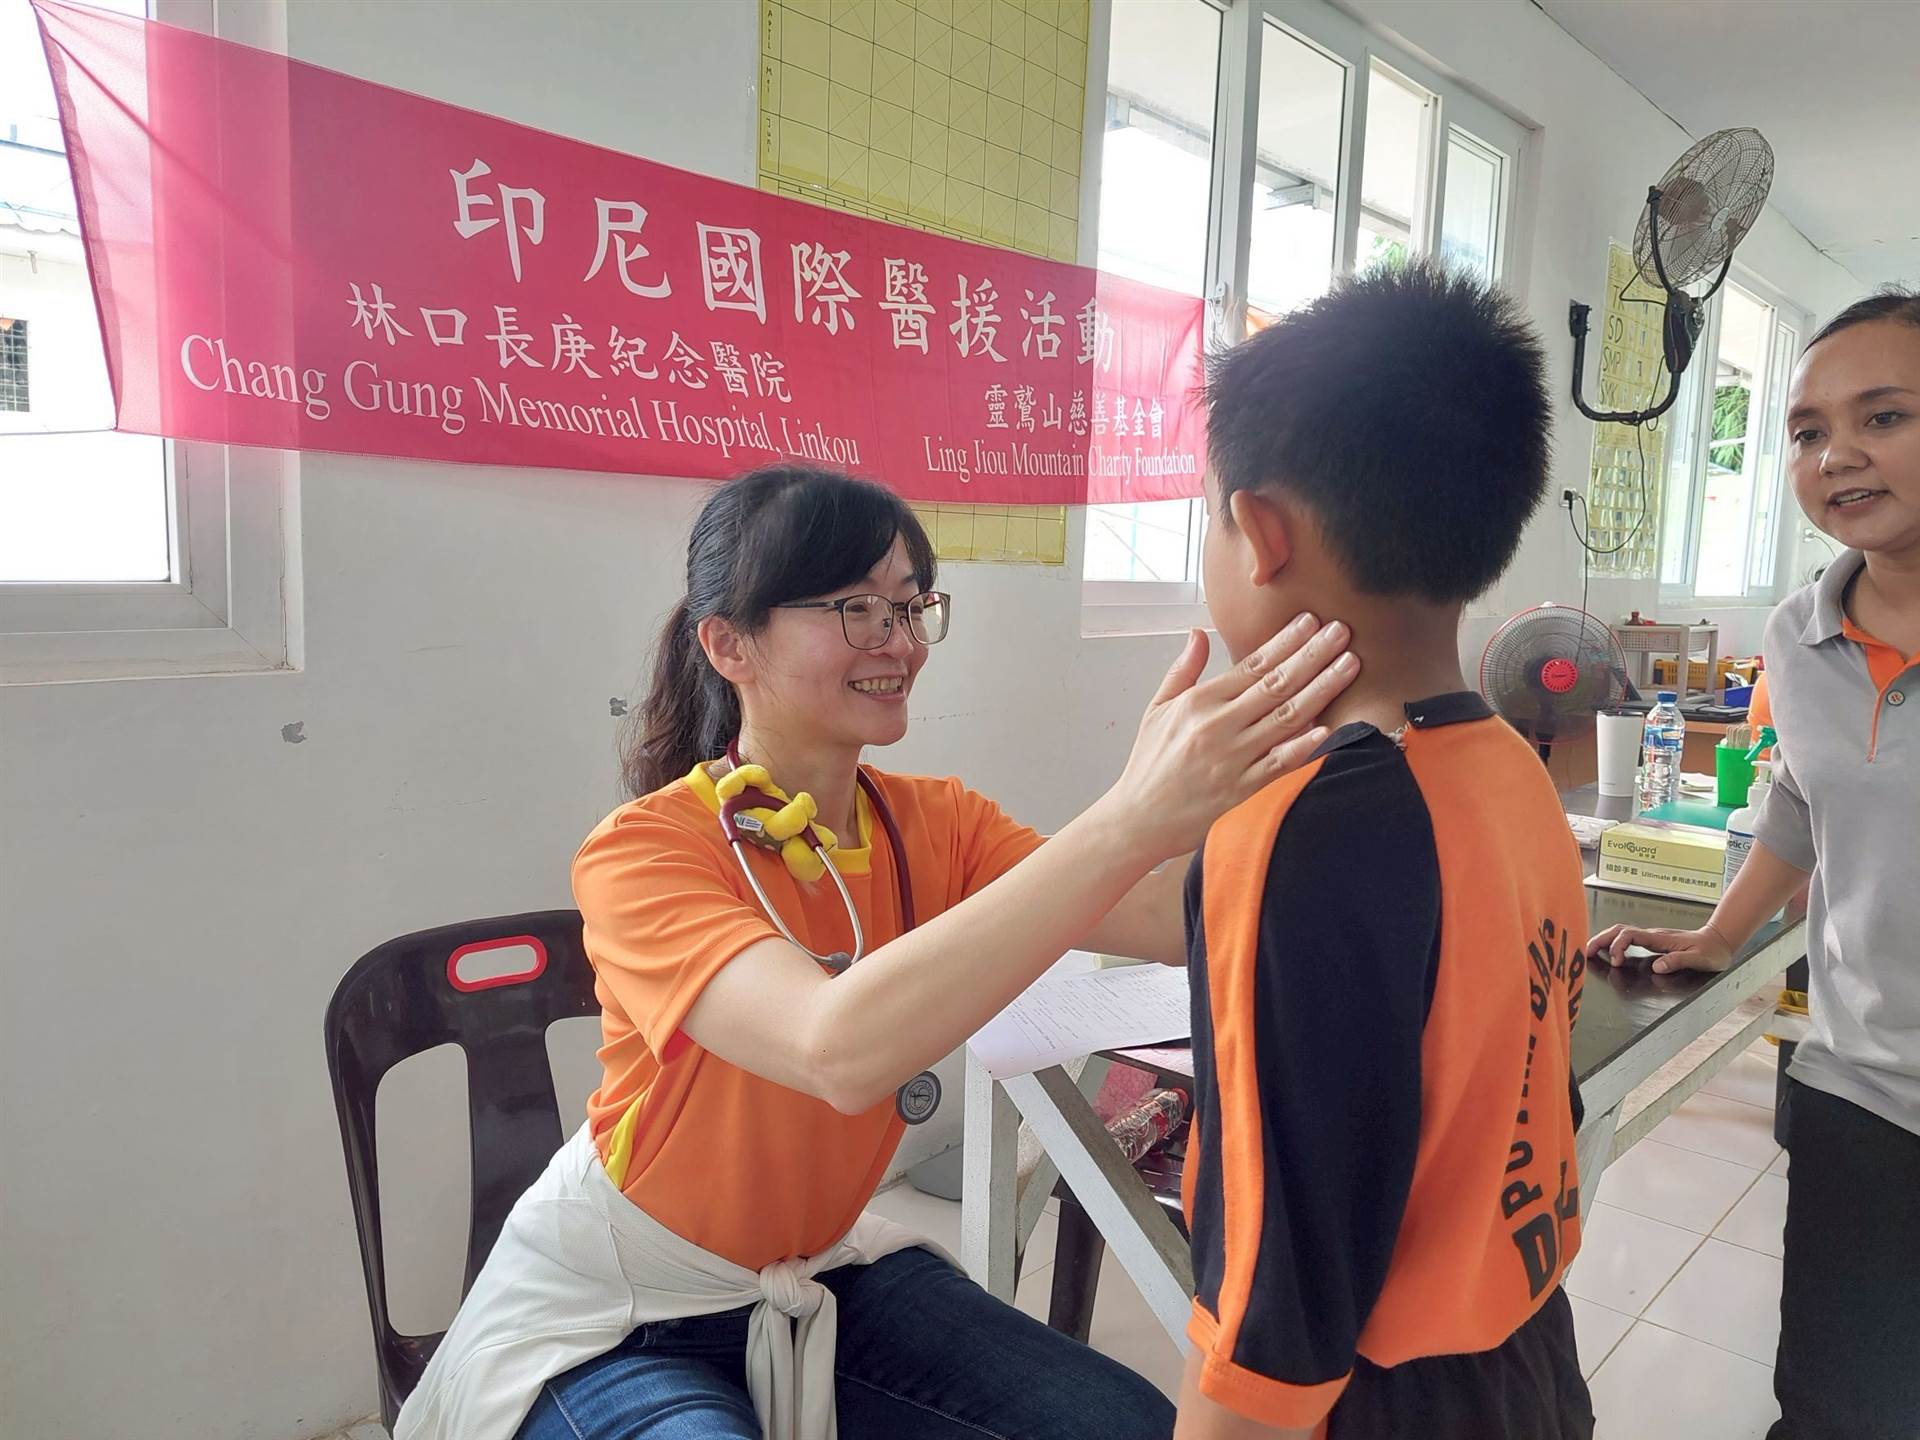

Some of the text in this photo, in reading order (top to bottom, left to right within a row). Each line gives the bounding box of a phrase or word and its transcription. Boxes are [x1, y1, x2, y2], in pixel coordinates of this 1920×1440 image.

[450, 158, 1114, 374] 印尼國際醫援活動
[347, 281, 792, 403] 林口長庚紀念醫院
[1608, 315, 1623, 343] SD
[180, 334, 861, 466] Chang Gung Memorial Hospital, Linkou
[984, 383, 1165, 438] 靈鷲山慈善基金會
[923, 435, 971, 484] Ling
[974, 439, 1008, 475] Jiou
[1011, 442, 1085, 477] Mountain
[1134, 446, 1196, 477] Foundation
